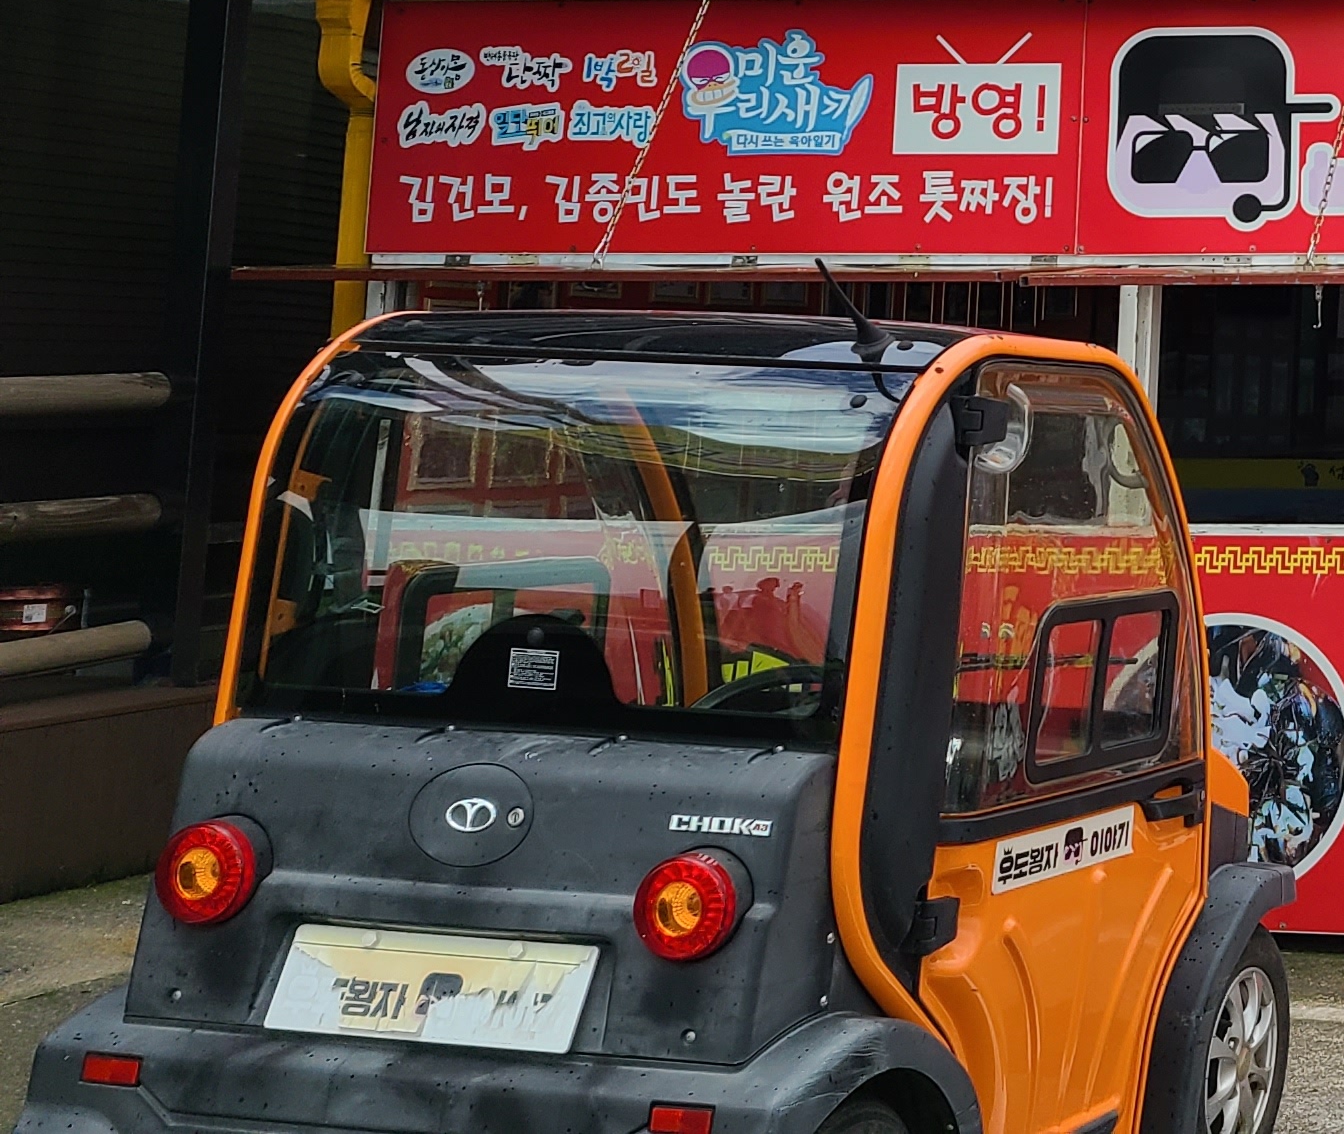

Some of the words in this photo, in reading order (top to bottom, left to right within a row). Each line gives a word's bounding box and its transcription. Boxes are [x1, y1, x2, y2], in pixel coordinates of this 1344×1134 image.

[506, 59, 566, 87] 단짝
[736, 34, 820, 85] 미운
[912, 81, 1046, 139] 방영!
[736, 134, 759, 148] 다시
[761, 134, 784, 148] 쓰는
[789, 134, 836, 148] 육아일기
[399, 174, 527, 223] 김건모,
[545, 174, 700, 223] 김종민도
[717, 174, 796, 222] 놀란
[822, 171, 903, 220] 원조
[919, 170, 1053, 224] 톳짜장!
[998, 842, 1059, 885] 우도왕자
[1090, 821, 1130, 857] 이야기
